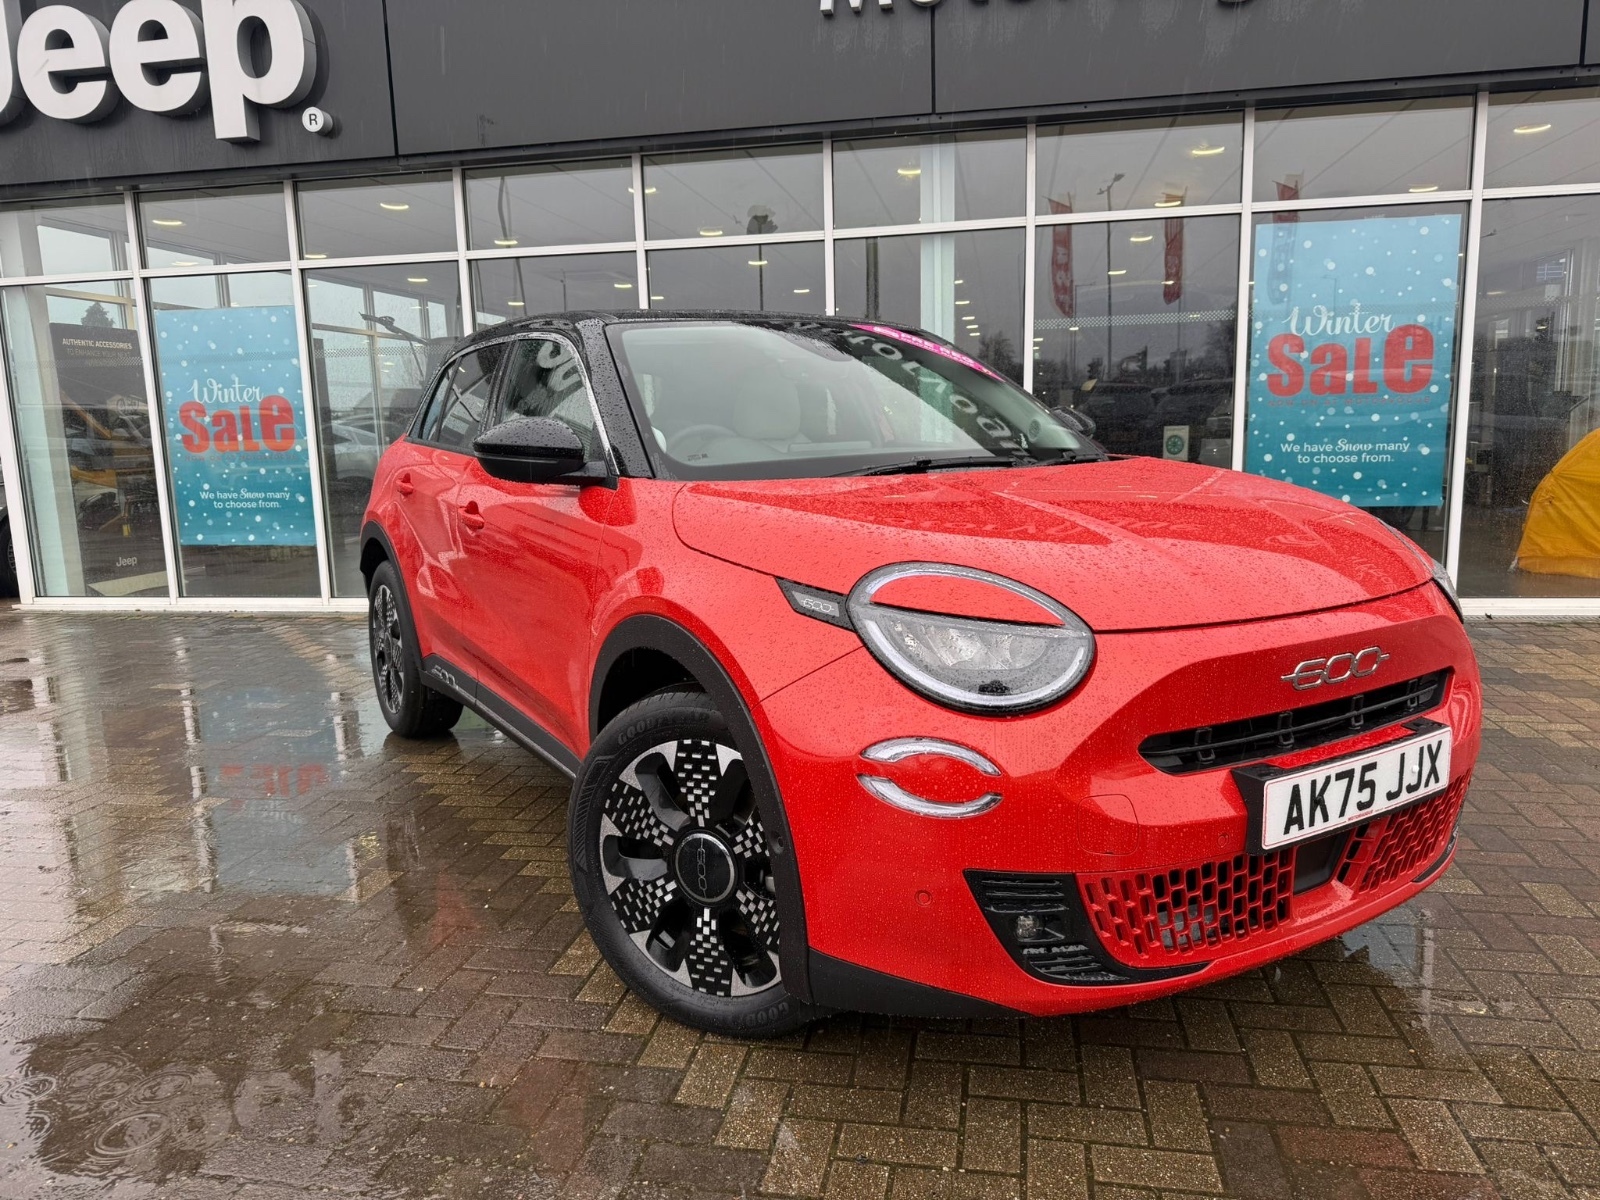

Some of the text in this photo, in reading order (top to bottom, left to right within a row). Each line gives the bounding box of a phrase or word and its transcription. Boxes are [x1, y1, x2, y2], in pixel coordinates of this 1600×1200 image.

[1281, 303, 1395, 336] Winter
[62, 338, 133, 350] AUTHENTIC ACCESSORIES
[187, 377, 263, 404] Winter
[1280, 438, 1411, 453] We have Snow many
[1297, 453, 1395, 464] to choose from.
[199, 488, 291, 501] We have Snow many
[213, 500, 282, 509] to choose from.
[116, 556, 138, 567] Jeep
[1281, 646, 1389, 691] 600
[1283, 740, 1443, 836] AK75 JJX
